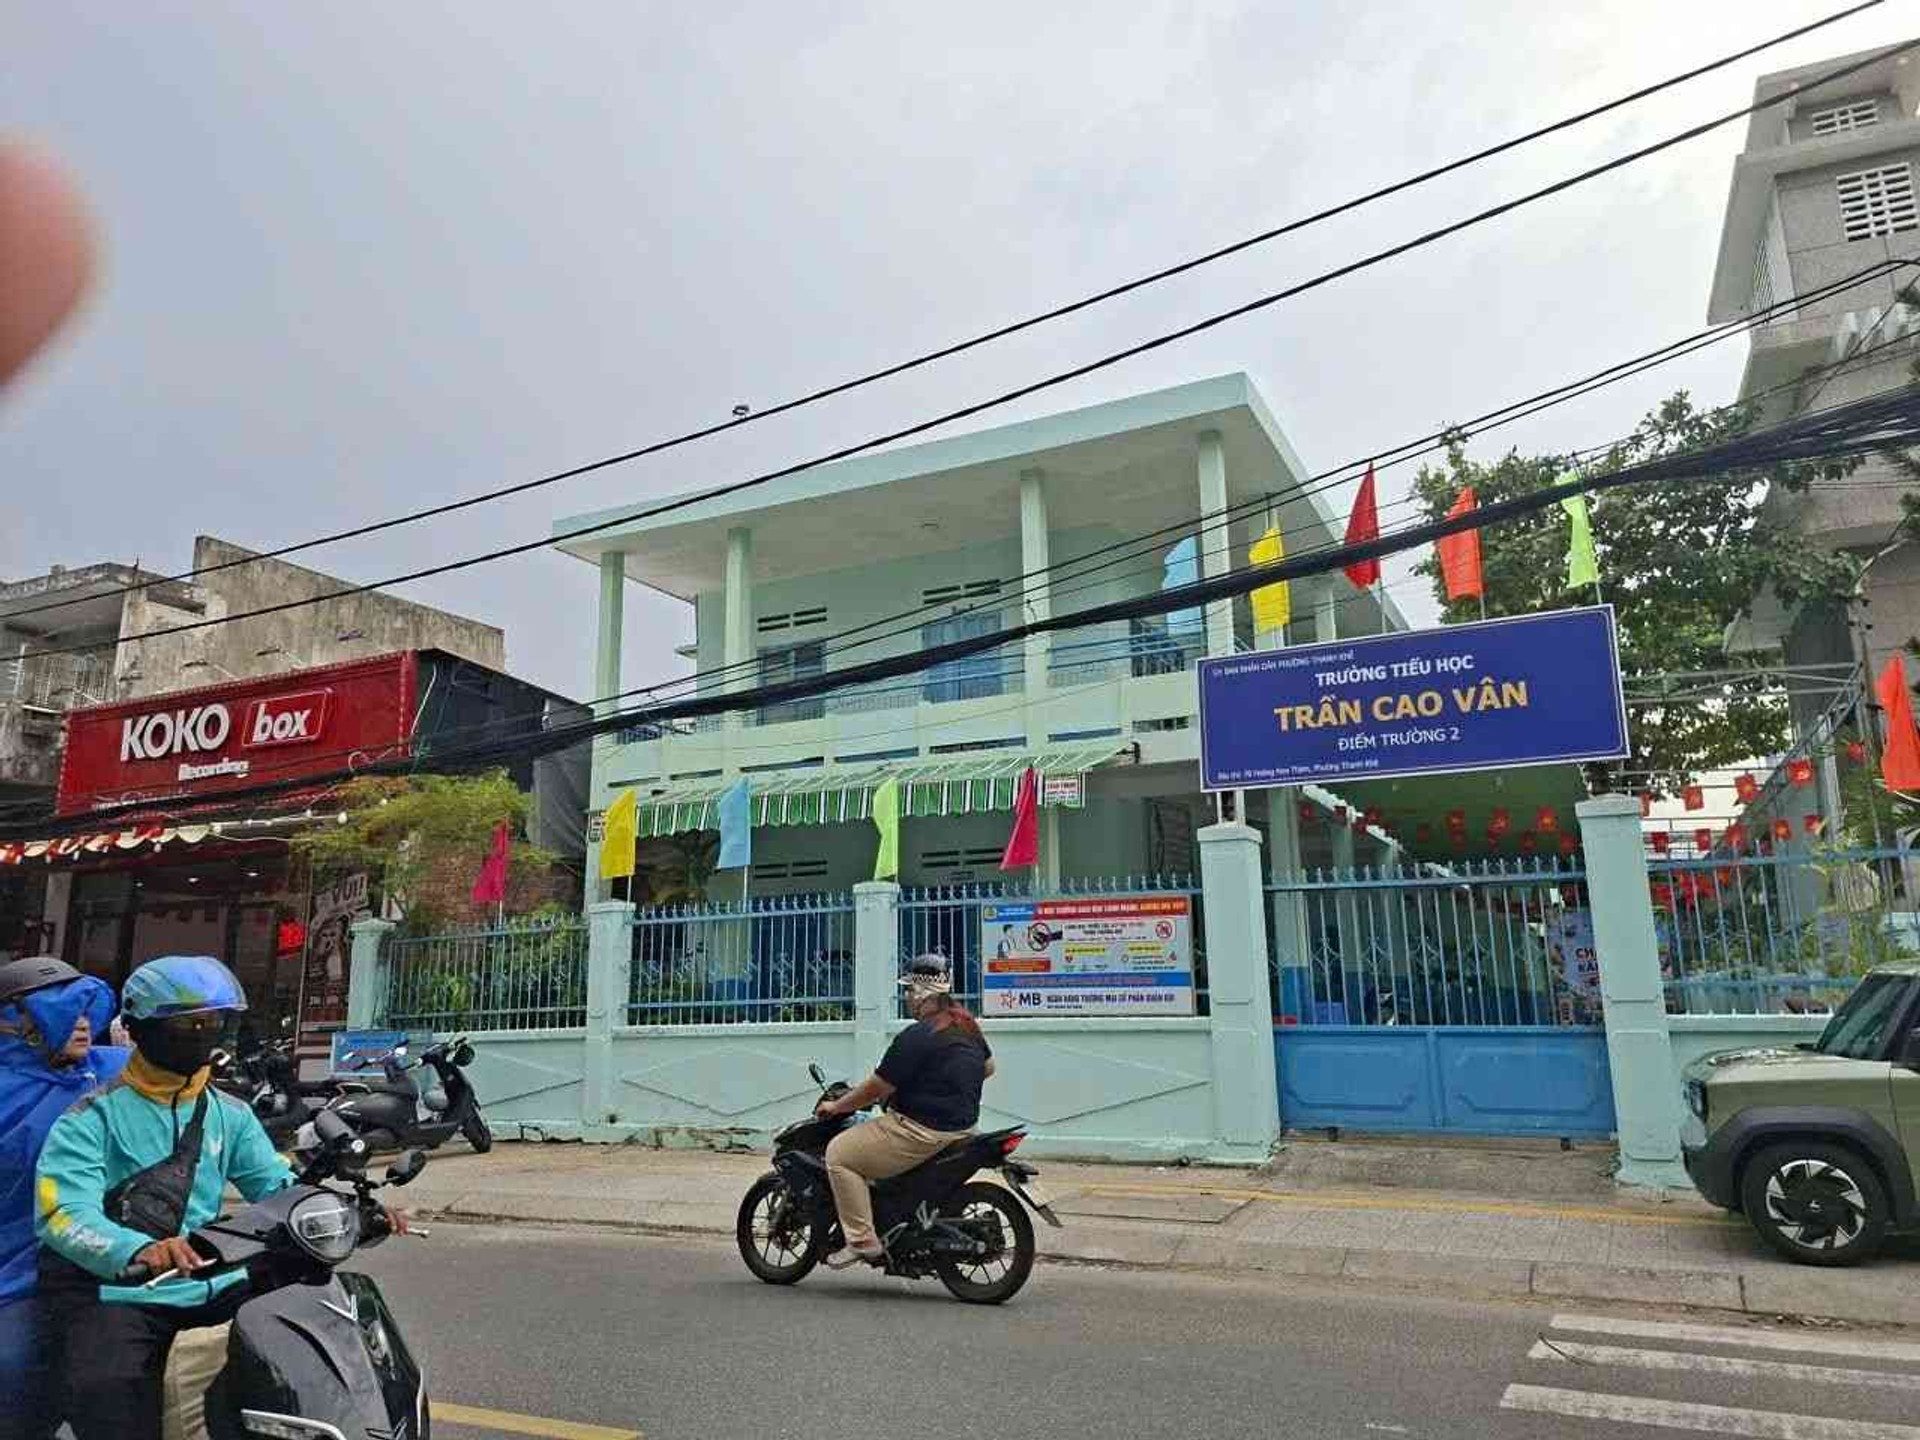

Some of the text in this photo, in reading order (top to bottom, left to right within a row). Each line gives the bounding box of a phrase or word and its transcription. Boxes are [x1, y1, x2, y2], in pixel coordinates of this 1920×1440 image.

[1315, 664, 1387, 687] TRƯỜNG
[1435, 655, 1475, 675] HỌC
[1273, 676, 1529, 732] TRẦN CAO VÂN
[120, 703, 311, 762] KOKO box
[1381, 726, 1447, 746] TRƯỜNG
[1450, 727, 1461, 741] 2
[1019, 992, 1041, 1006] MB
